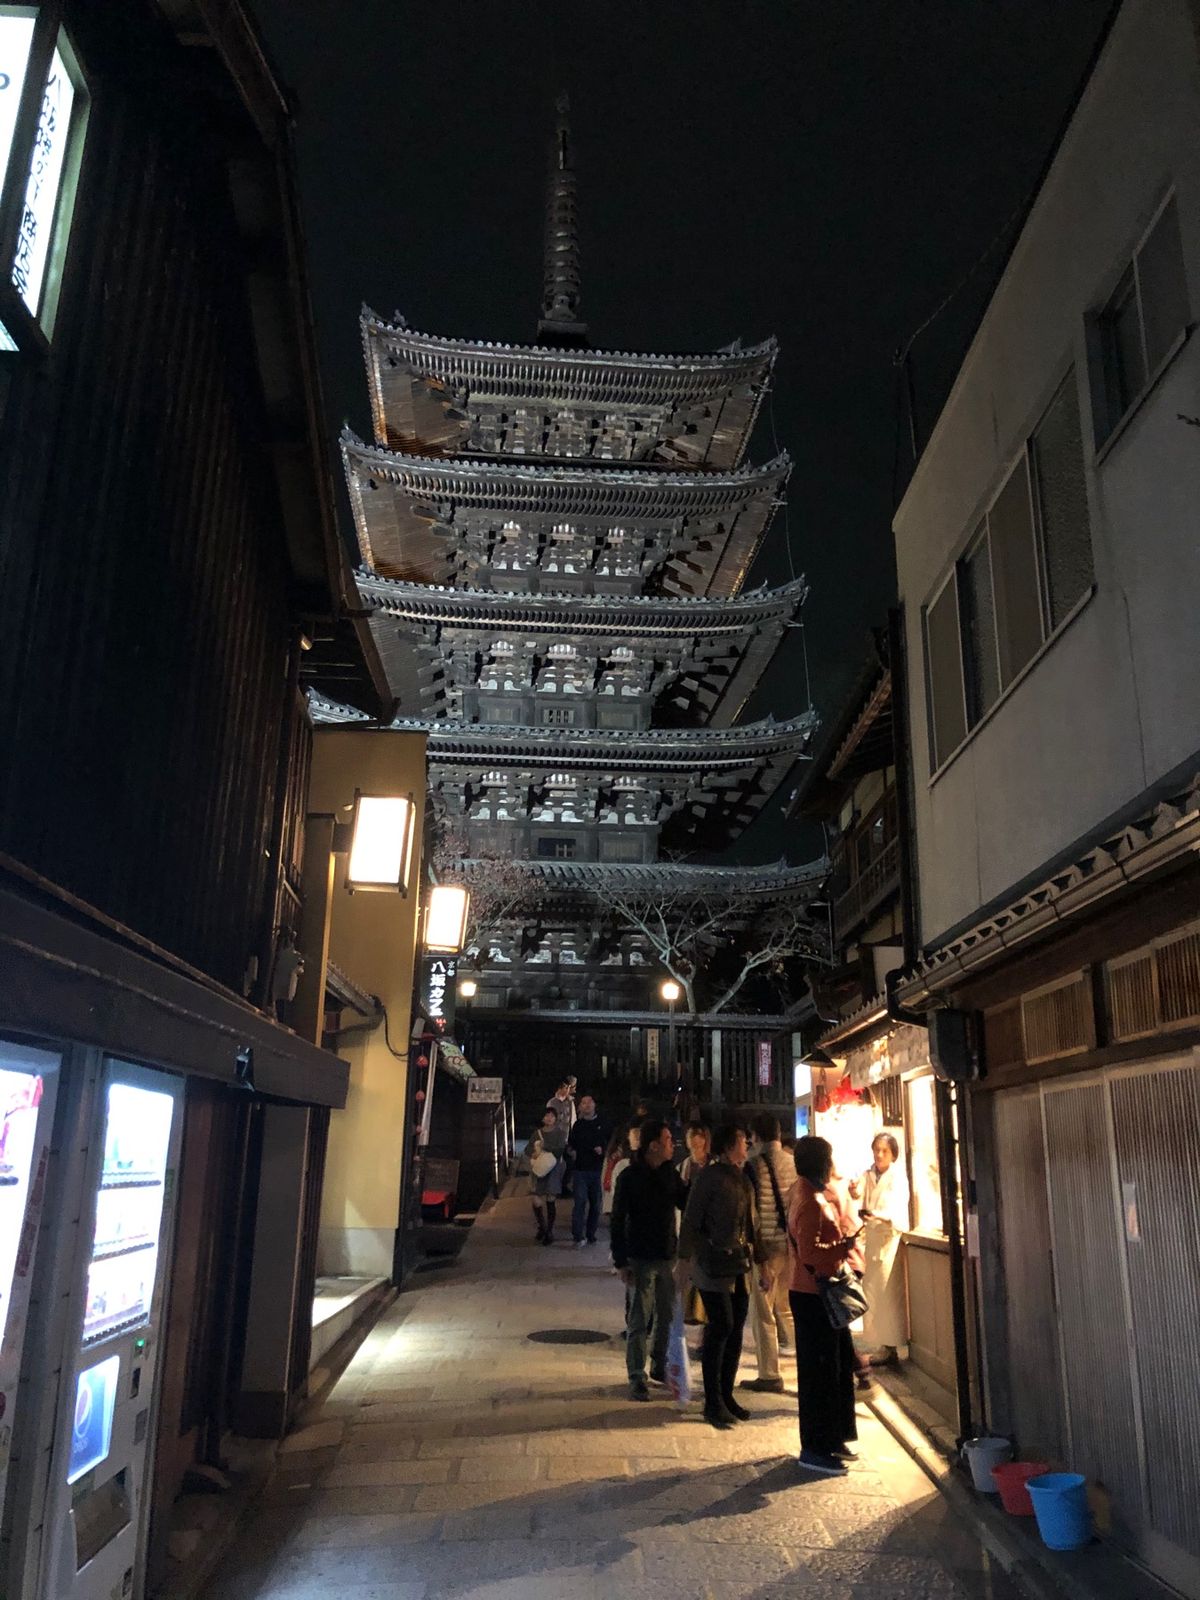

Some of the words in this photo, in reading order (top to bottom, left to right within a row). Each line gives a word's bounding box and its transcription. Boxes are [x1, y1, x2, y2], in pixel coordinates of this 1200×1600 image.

[429, 960, 447, 1017] 八坂カフェ
